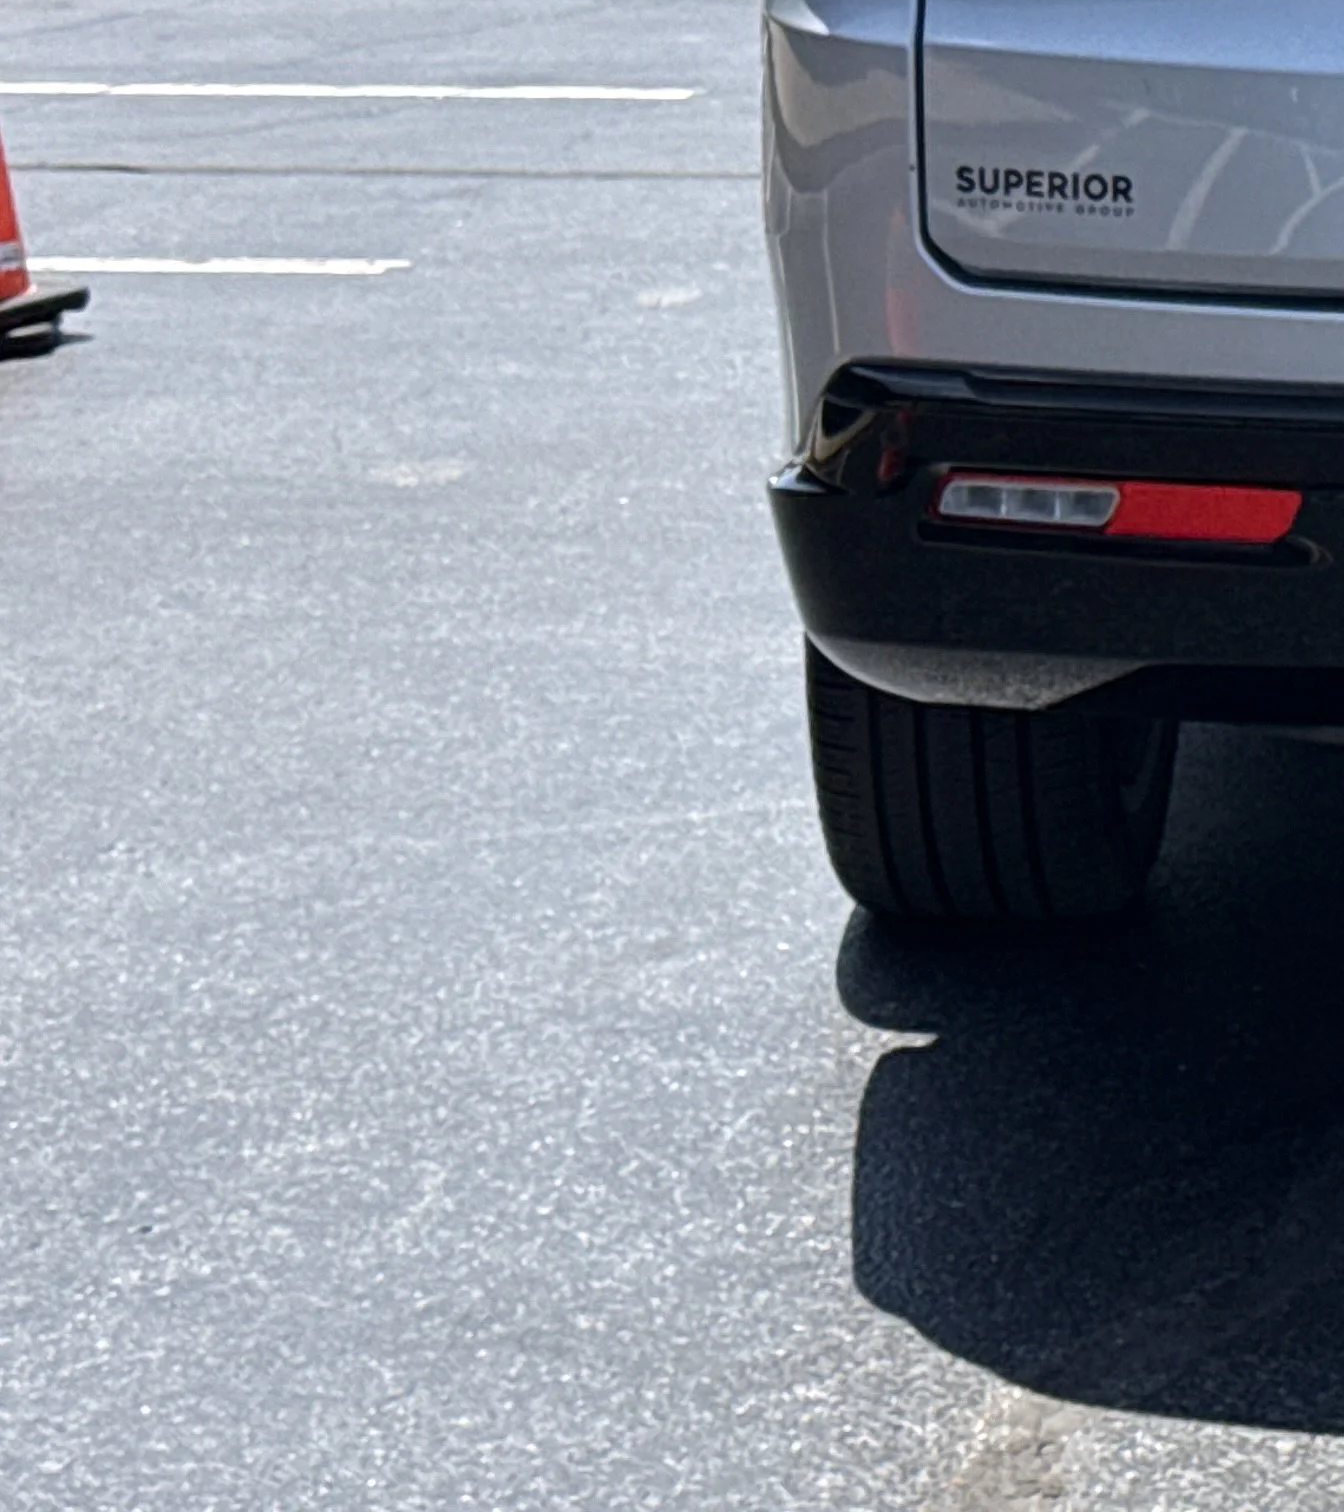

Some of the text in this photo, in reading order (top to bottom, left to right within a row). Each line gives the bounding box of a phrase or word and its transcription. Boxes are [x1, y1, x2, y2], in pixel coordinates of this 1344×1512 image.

[955, 165, 1134, 204] SUPERIOR
[956, 197, 1136, 218] AUTOMOTIVE GROUP
